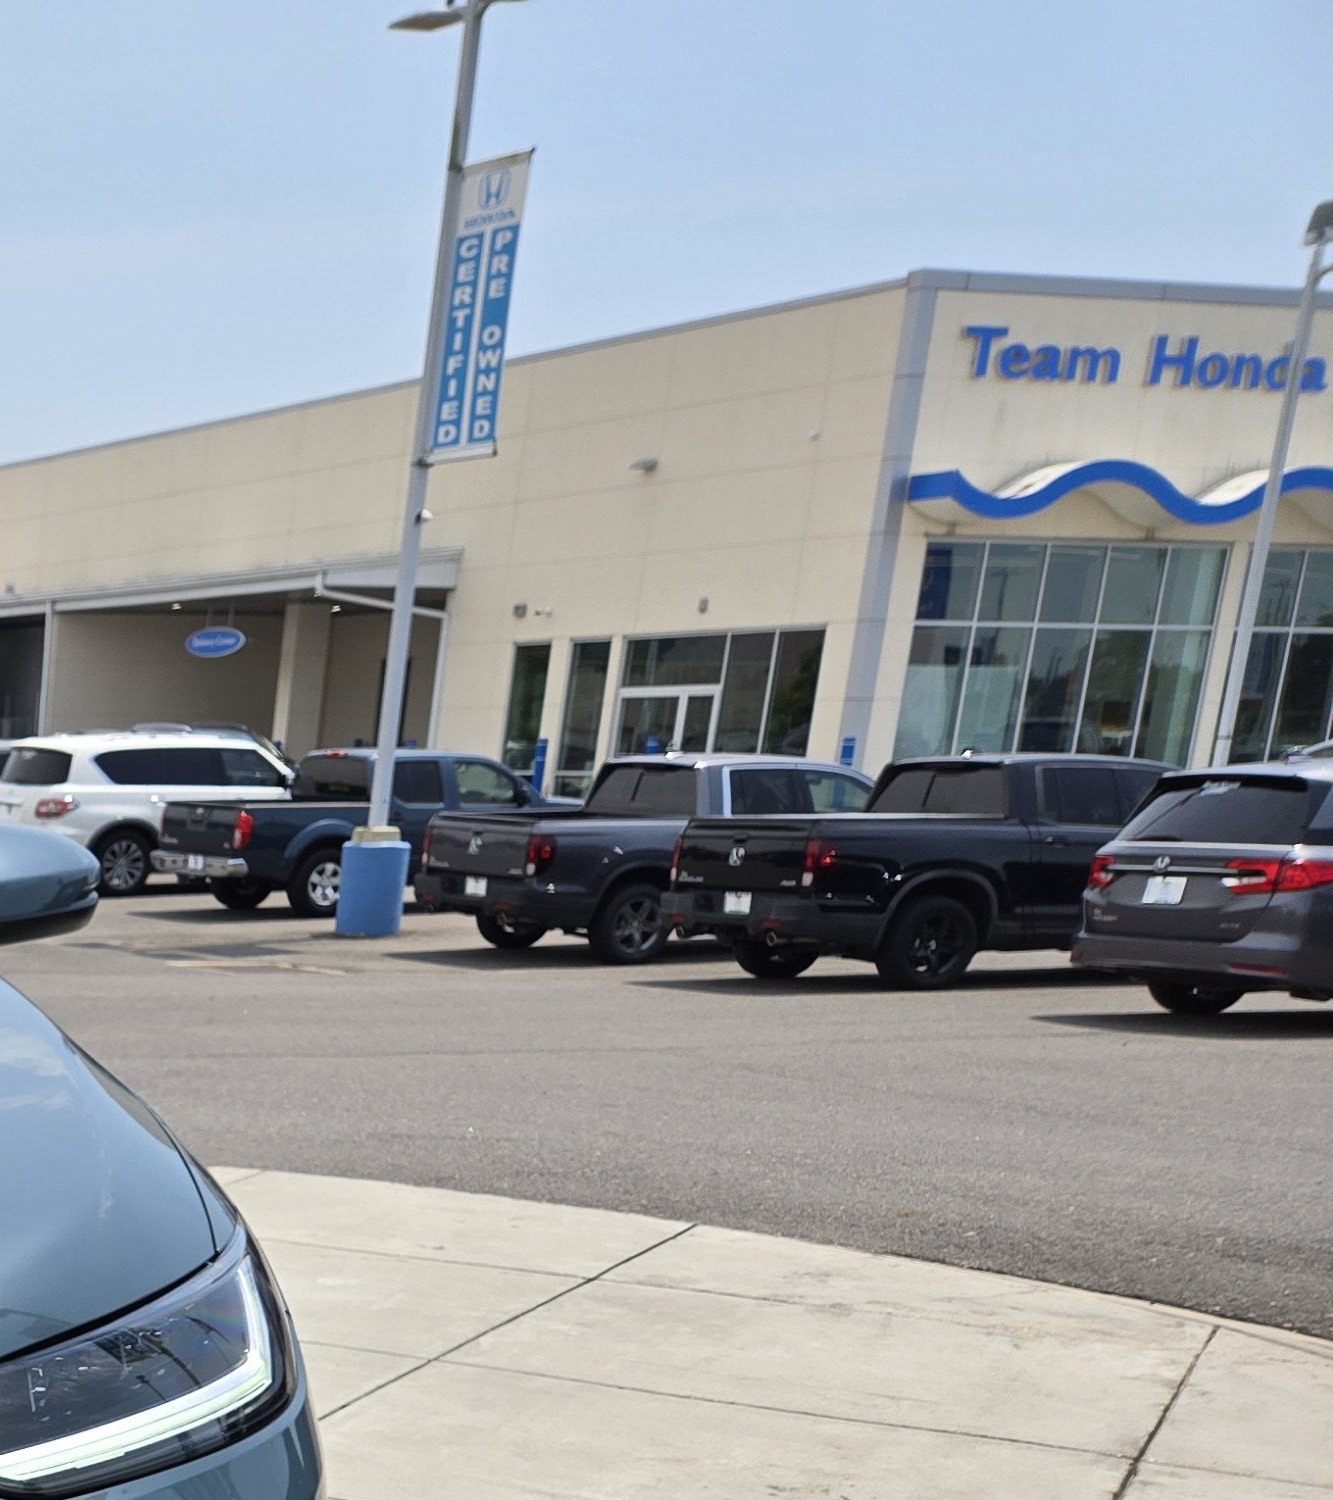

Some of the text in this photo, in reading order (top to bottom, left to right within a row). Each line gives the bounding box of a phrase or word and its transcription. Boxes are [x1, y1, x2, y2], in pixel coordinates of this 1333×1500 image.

[436, 237, 480, 444] CERTIFIED
[472, 228, 514, 440] PRE OWNED
[965, 325, 1327, 393] Team Honda
